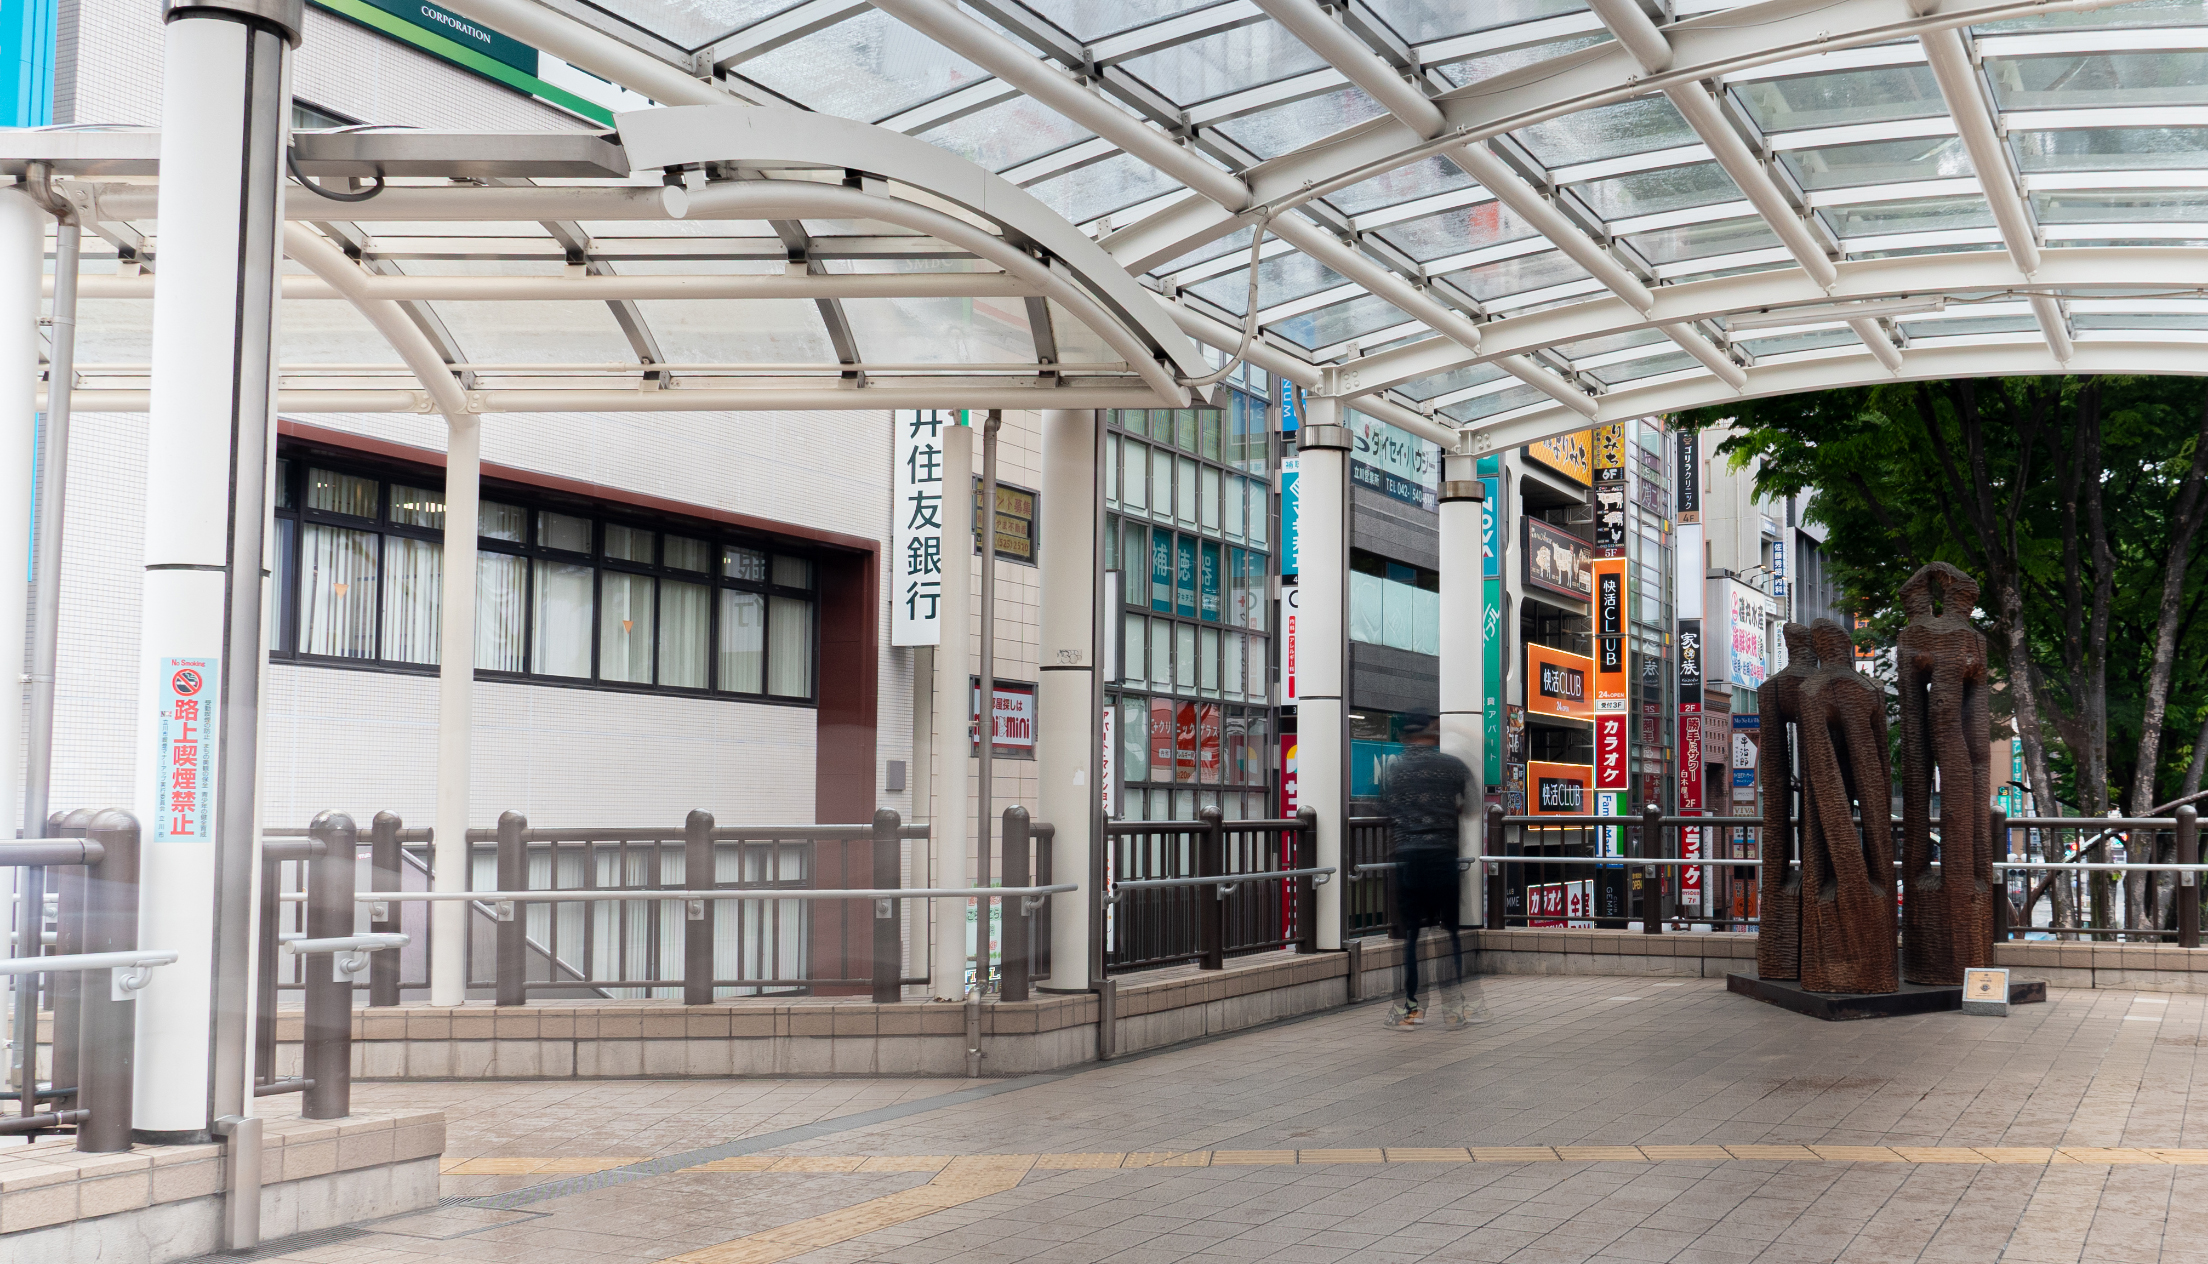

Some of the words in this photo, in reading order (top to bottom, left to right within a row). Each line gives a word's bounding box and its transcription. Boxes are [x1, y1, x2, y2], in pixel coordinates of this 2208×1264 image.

[421, 5, 491, 44] CORPORATION
[1386, 477, 1396, 493] TEL
[1602, 468, 1617, 480] 6F
[1684, 445, 1692, 510] ゴリラクリニック
[1683, 513, 1695, 523] 4F
[1605, 548, 1618, 557] 5F
[1603, 579, 1617, 666] 快活CLUB
[181, 659, 206, 667] Smoking
[1543, 668, 1582, 697] 快活CLUB
[1684, 704, 1696, 712] 2F
[1006, 716, 1030, 740] mini
[1603, 720, 1620, 783] カラオケ
[1686, 717, 1701, 782] 勝手にサワー
[170, 699, 200, 836] 路上喫煙禁止
[1542, 783, 1581, 807] 快活CLUB
[1685, 799, 1696, 808] 2F
